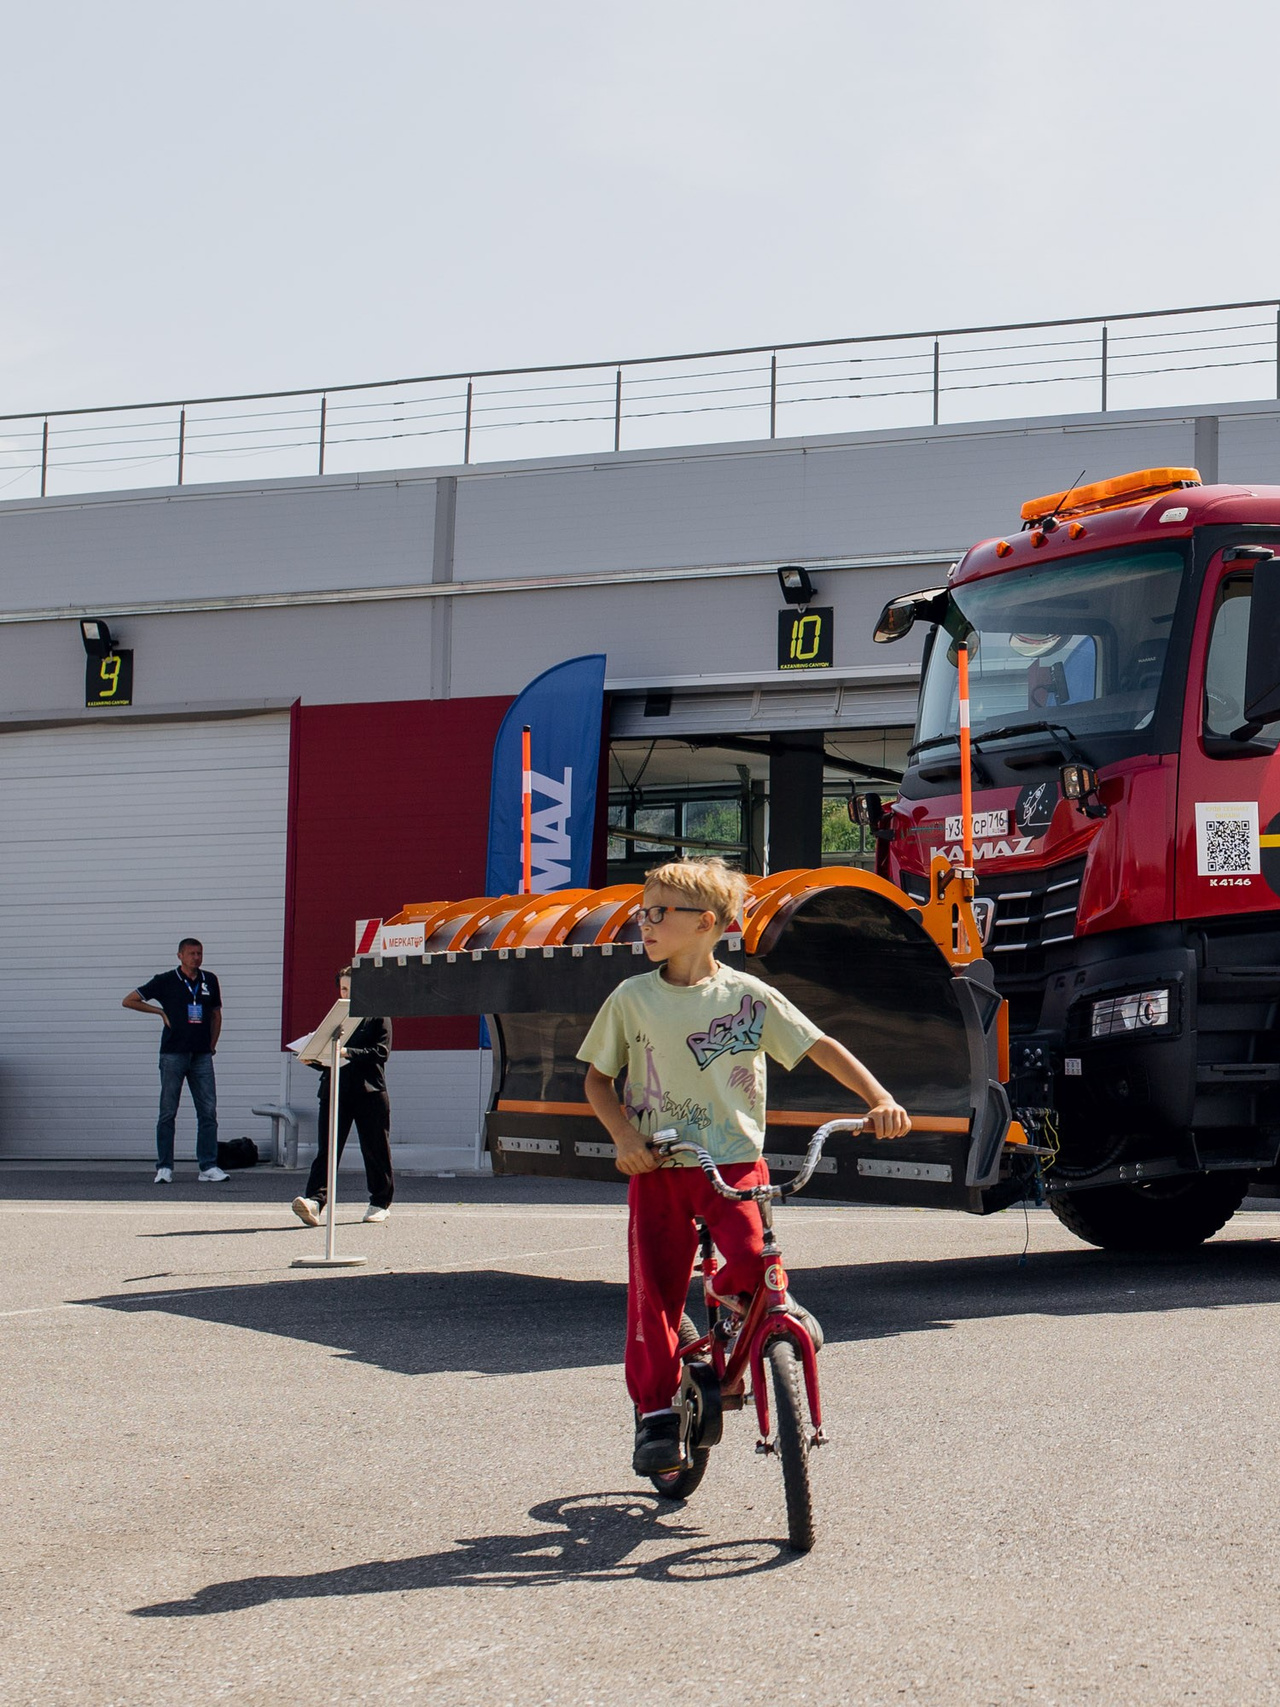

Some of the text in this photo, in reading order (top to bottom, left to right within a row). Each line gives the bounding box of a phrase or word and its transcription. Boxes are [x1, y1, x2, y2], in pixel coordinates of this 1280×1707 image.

[790, 615, 821, 660] 10
[99, 656, 121, 697] 9
[930, 836, 1035, 862] KAMAZ
